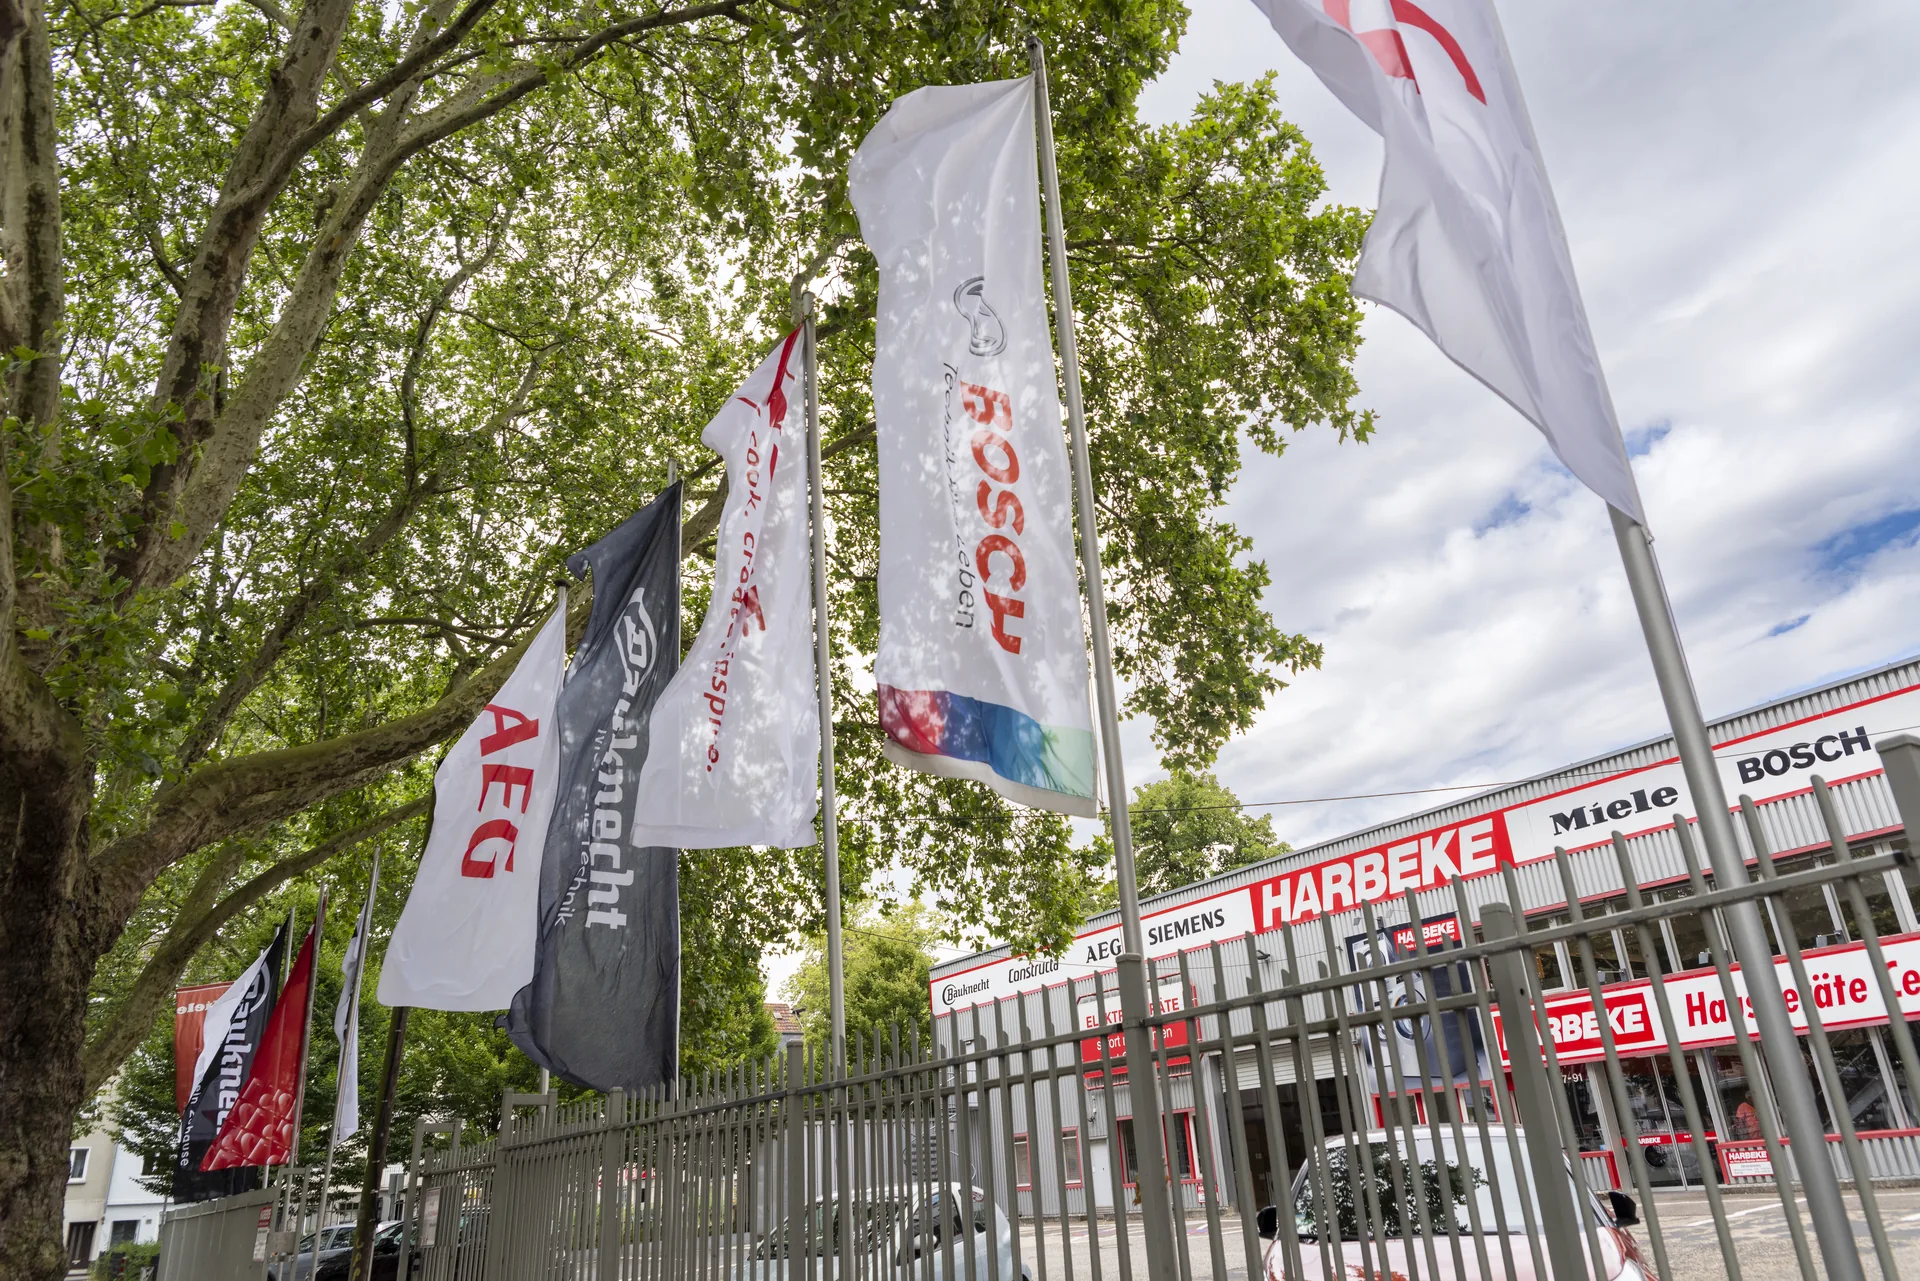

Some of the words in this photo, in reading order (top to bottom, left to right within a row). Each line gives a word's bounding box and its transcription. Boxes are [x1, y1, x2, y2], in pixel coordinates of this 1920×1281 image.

[959, 379, 1027, 656] BOSCH
[956, 534, 975, 629] Leben
[1737, 726, 1872, 785] BOSCH
[461, 703, 539, 879] AEG
[1549, 786, 1679, 836] Miele
[1262, 818, 1496, 929] HARBEKE
[1148, 908, 1225, 946] SIEMENS
[1397, 920, 1455, 944] HABEKE
[1008, 959, 1059, 984] Constructa
[1086, 938, 1122, 964] AEG
[943, 979, 990, 1004] Bauknecht
[1503, 1003, 1645, 1051] RBEKE
[1638, 1136, 1661, 1145] ARBEKE
[1728, 1150, 1768, 1160] HARBEKE
